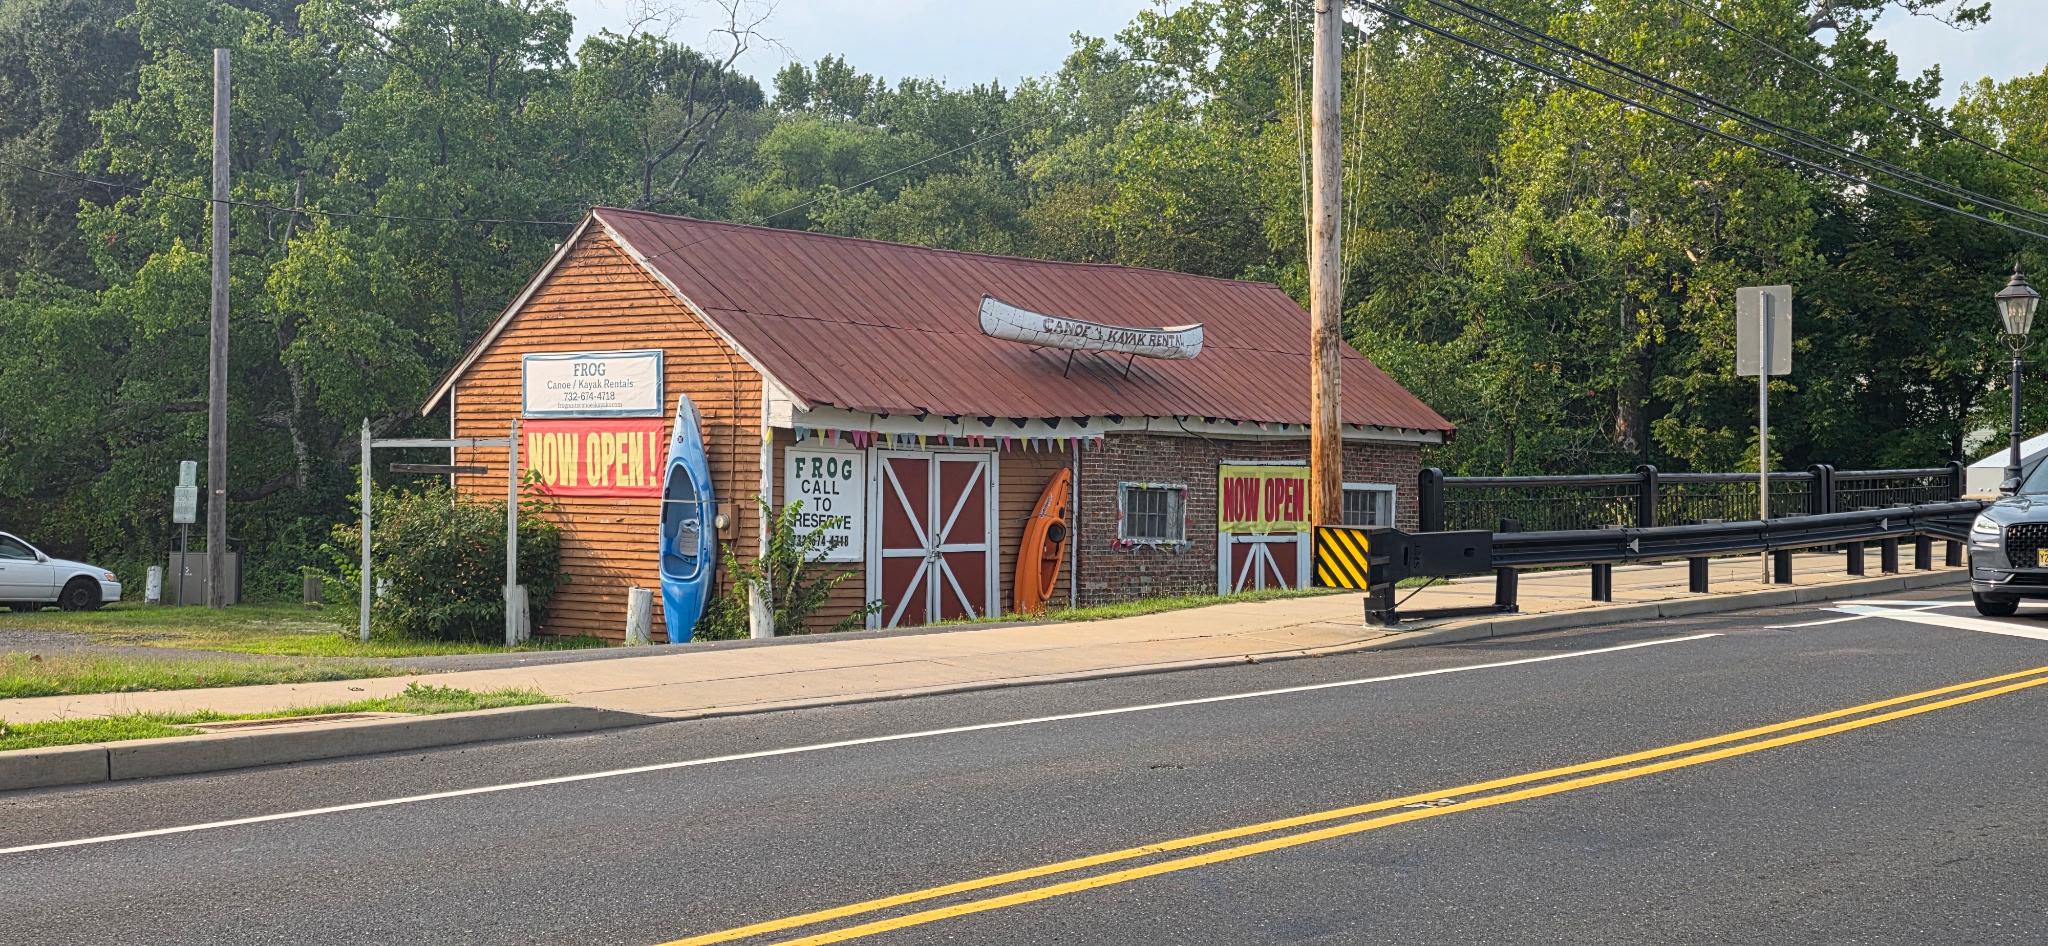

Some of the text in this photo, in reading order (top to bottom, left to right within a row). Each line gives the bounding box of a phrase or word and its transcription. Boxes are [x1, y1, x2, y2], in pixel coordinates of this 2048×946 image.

[1042, 318, 1091, 337] CANOE
[1108, 330, 1147, 346] KAYAK
[573, 362, 607, 377] FROG
[547, 380, 571, 389] Canoe
[578, 379, 602, 391] Kayak
[603, 378, 634, 389] Rentals
[563, 391, 616, 402] 732-674-4718
[528, 432, 579, 487] NOW
[795, 457, 852, 480] FROG
[801, 479, 840, 495] CALL
[813, 497, 832, 512] TO
[1223, 476, 1260, 522] NOW
